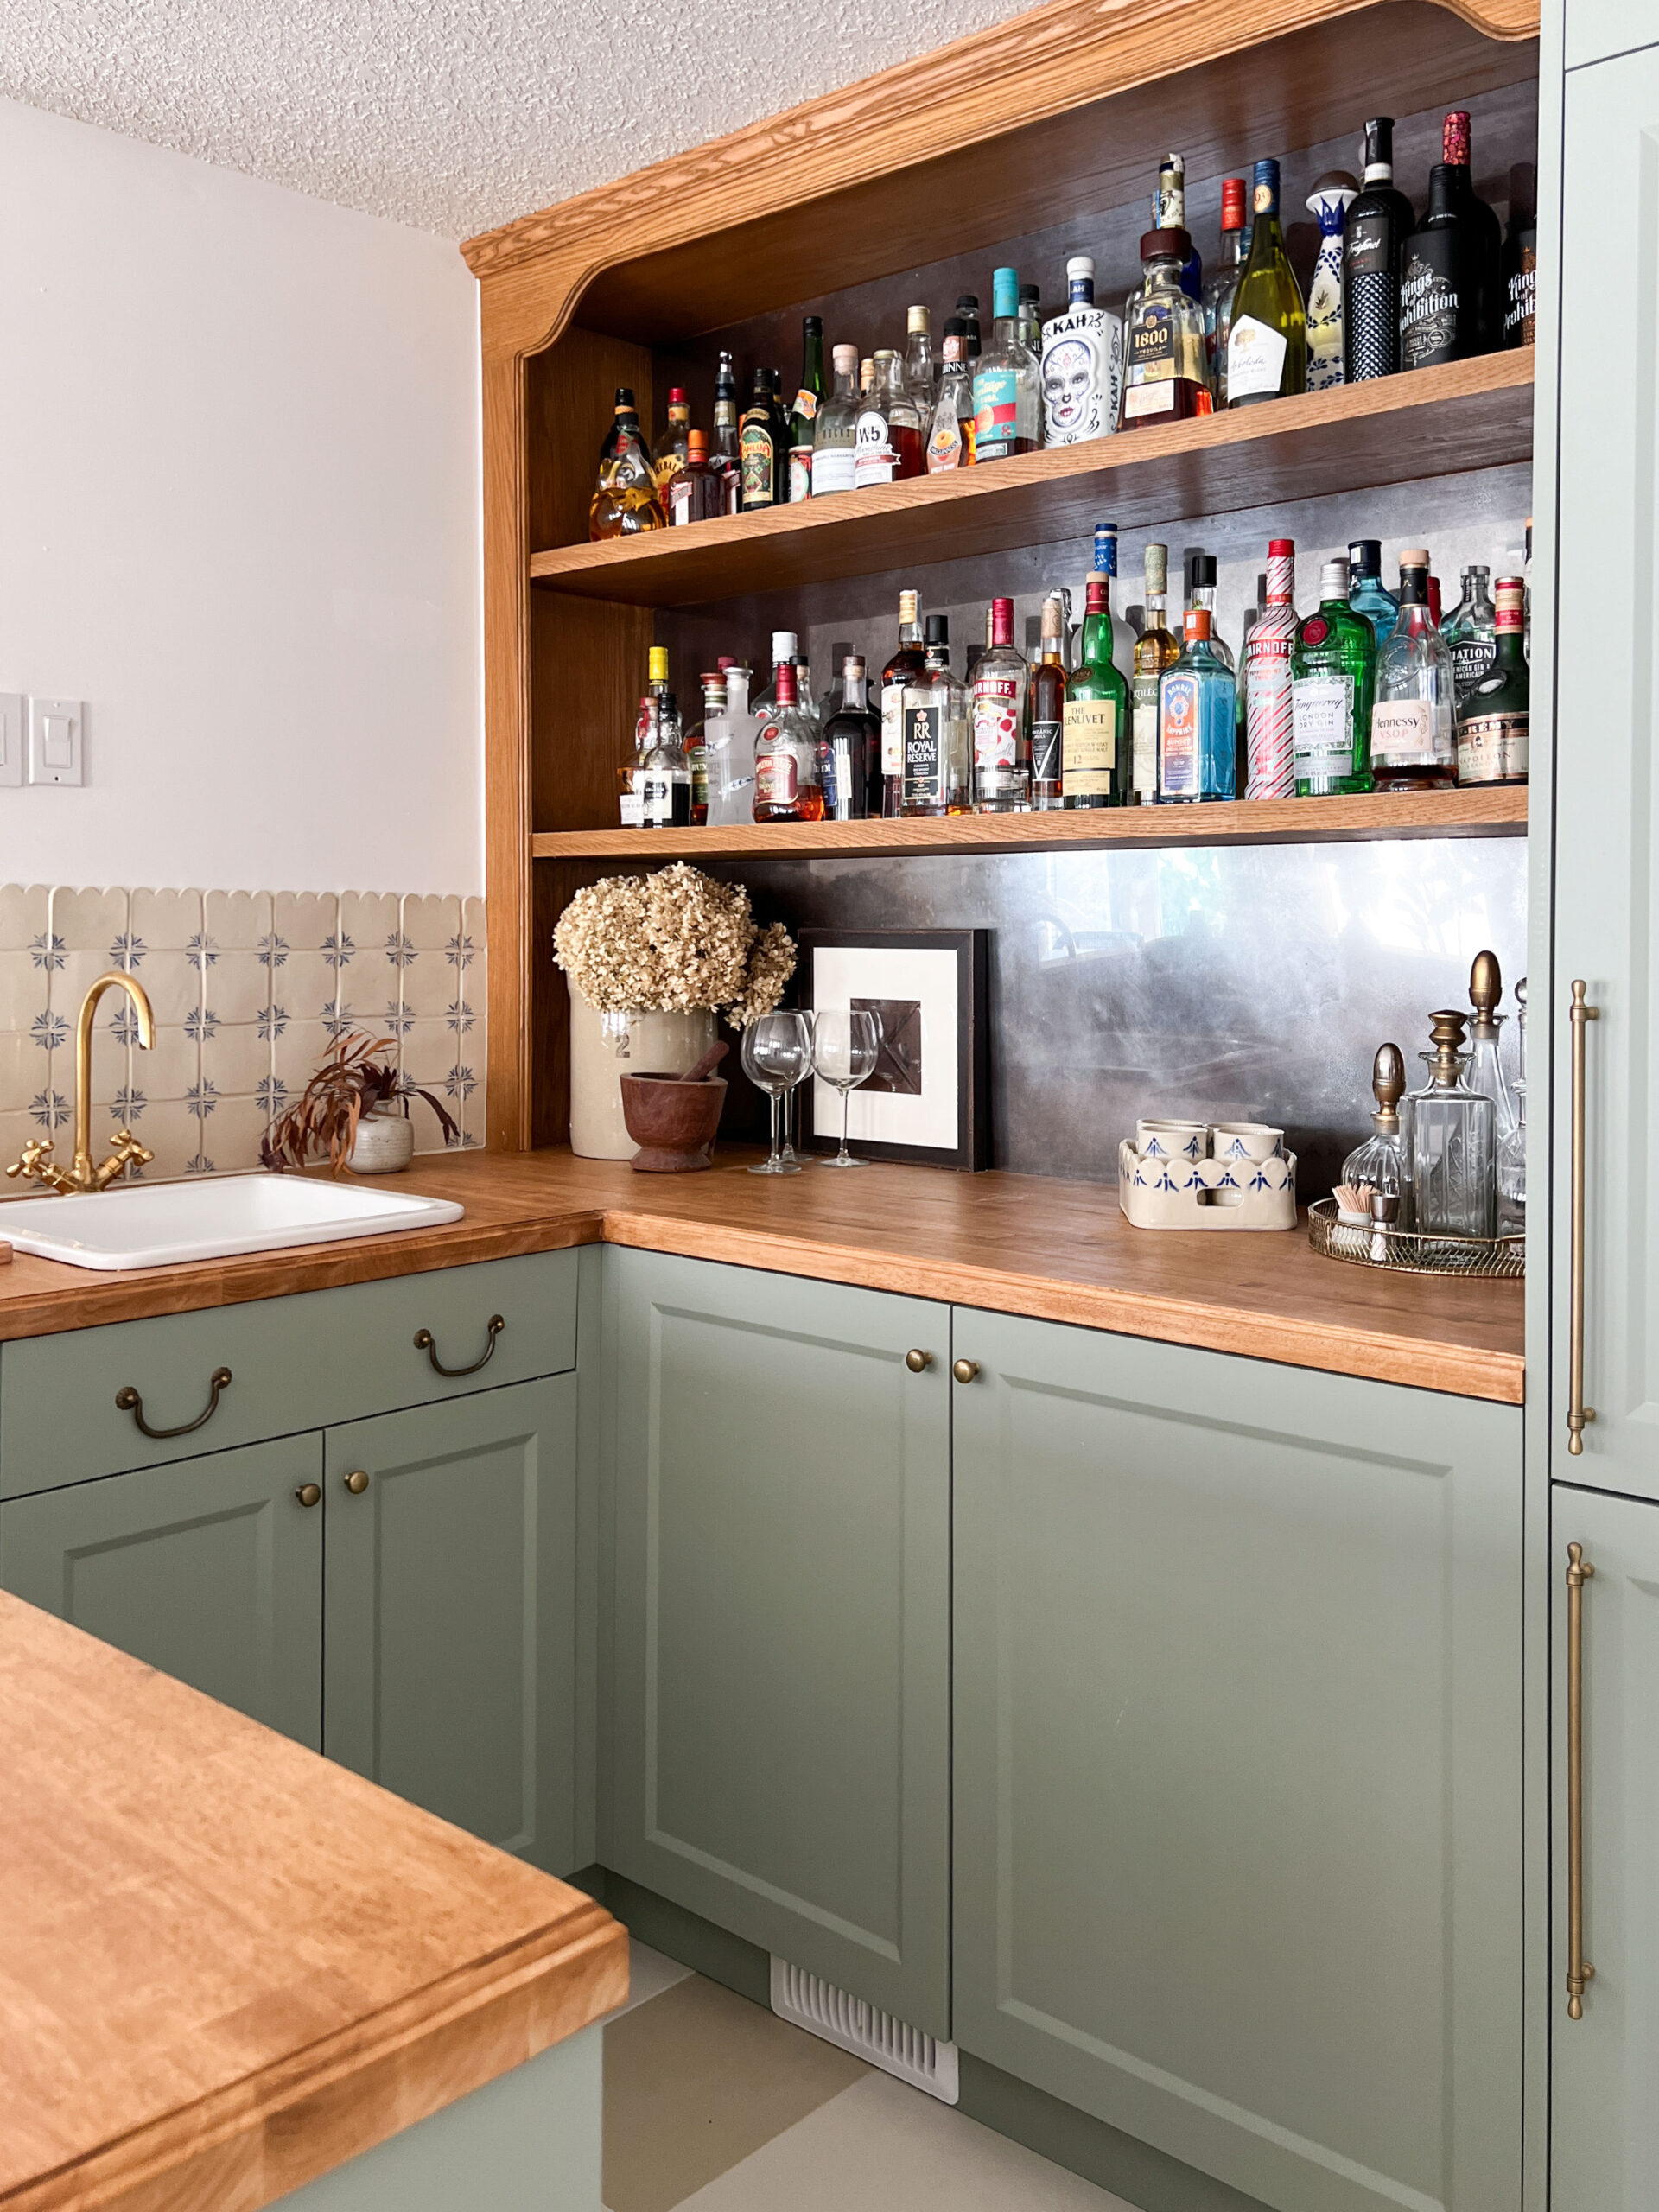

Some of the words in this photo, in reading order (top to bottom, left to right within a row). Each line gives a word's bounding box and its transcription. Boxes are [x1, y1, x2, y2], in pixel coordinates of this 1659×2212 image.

[1071, 284, 1085, 294] AH
[1401, 272, 1433, 308] Kings
[1399, 292, 1459, 337] rohibition
[1052, 313, 1087, 335] KAH
[1135, 327, 1168, 348] 1800
[1139, 346, 1163, 355] TEQUILA
[1109, 374, 1119, 411] KAH
[1247, 641, 1294, 658] MIRNOFF
[1452, 647, 1493, 662] IATION
[1166, 683, 1192, 697] BOMBAY
[1071, 706, 1085, 715] THE
[1299, 712, 1334, 722] LONDON
[1299, 720, 1313, 730] DRY
[1375, 717, 1420, 729] Hennessy
[913, 722, 931, 740] RR
[907, 740, 938, 753] ROYAL
[907, 752, 938, 763] RESERVE
[1073, 754, 1083, 765] 12
[614, 1033, 631, 1058] 2
